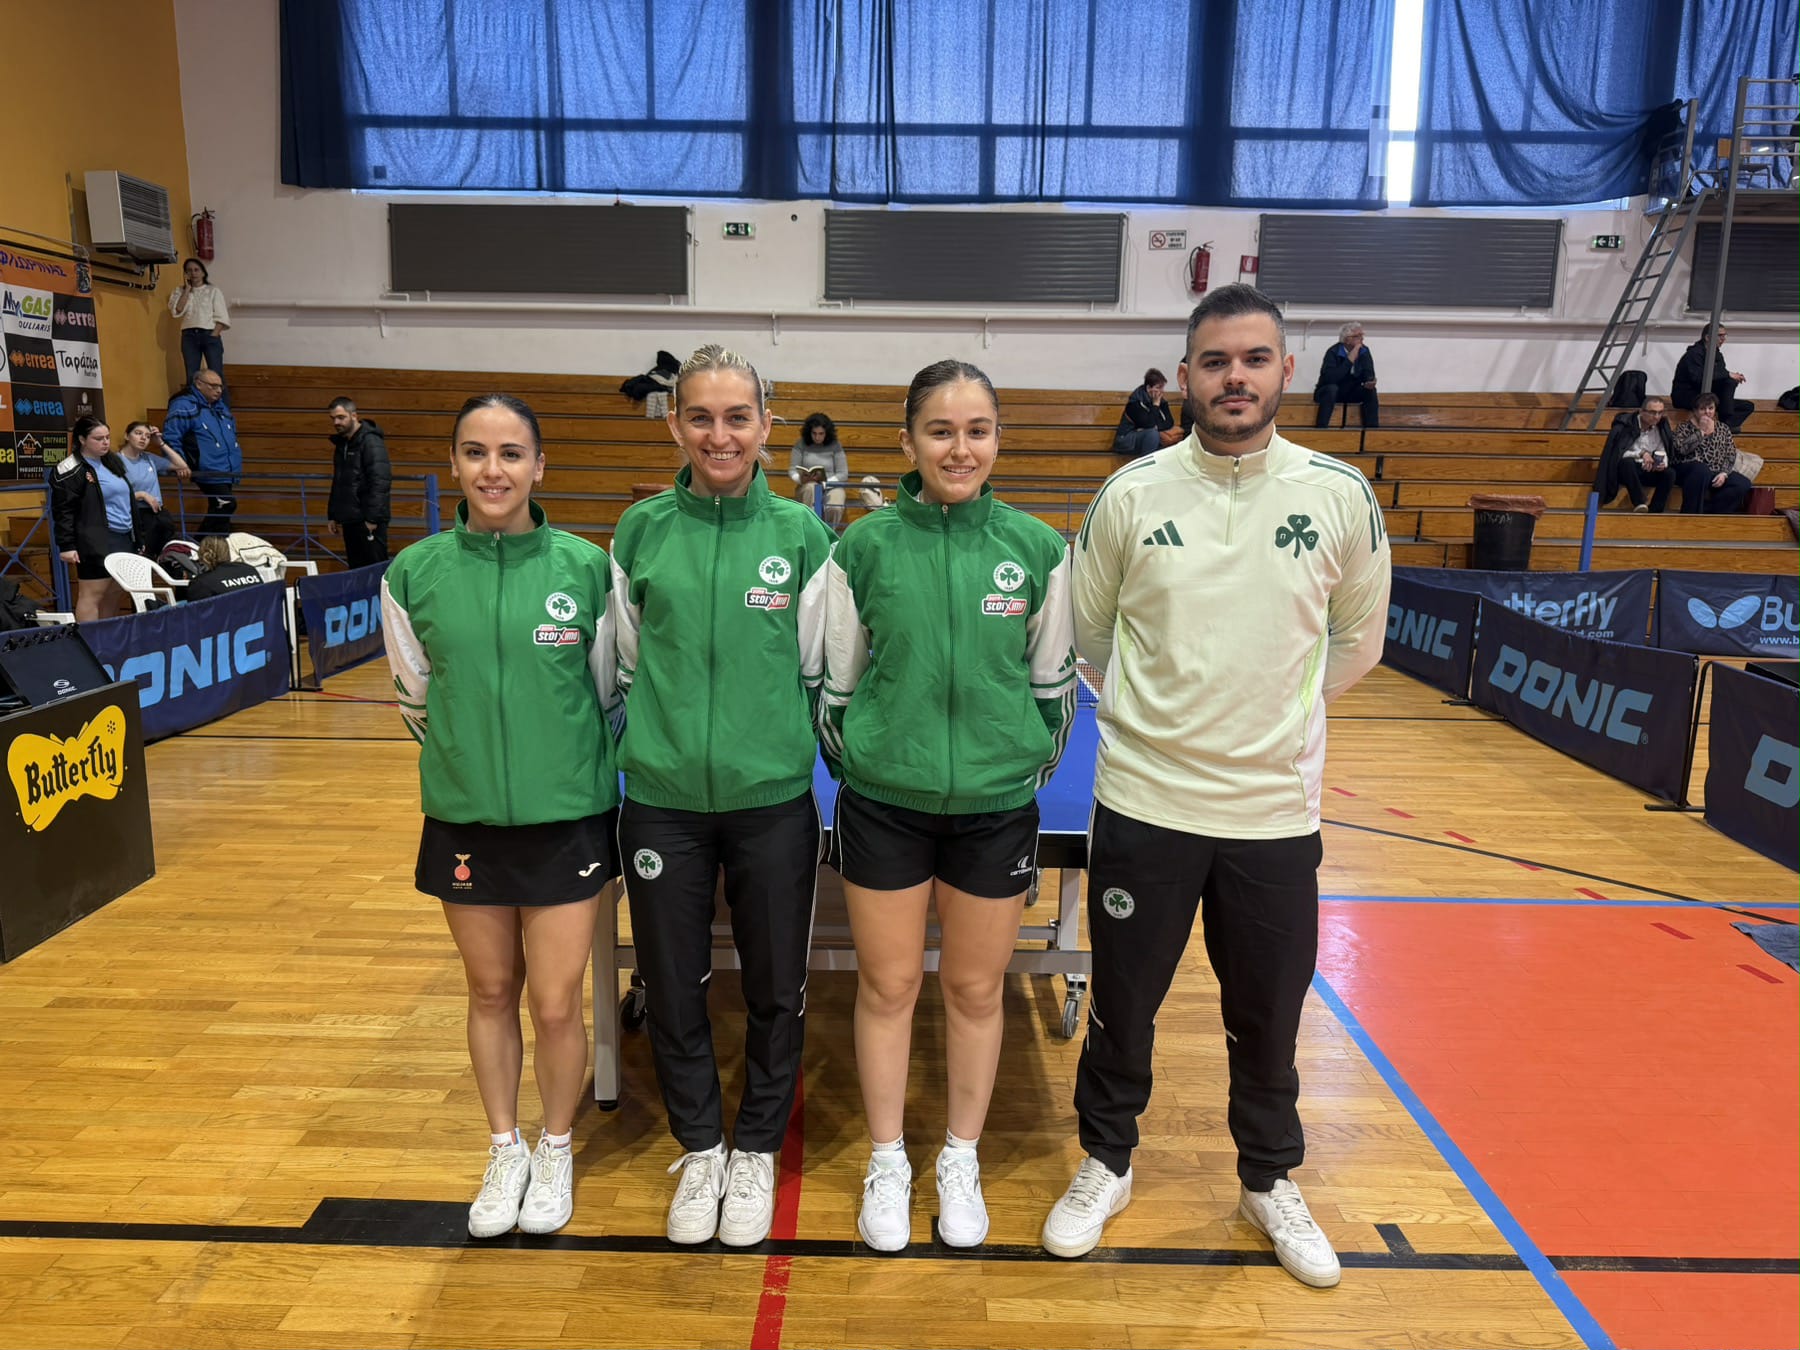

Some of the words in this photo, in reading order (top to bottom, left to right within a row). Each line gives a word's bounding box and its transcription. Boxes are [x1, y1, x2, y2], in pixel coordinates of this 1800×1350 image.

[67, 311, 95, 328] errea
[25, 352, 56, 370] errea
[33, 400, 65, 416] errea
[1504, 591, 1618, 629] tterfly
[1760, 596, 1800, 631] Bu
[1386, 603, 1458, 660] ONIC
[103, 621, 266, 708] ONIC
[1488, 644, 1653, 745] DONIC
[24, 735, 117, 806] Butterfly
